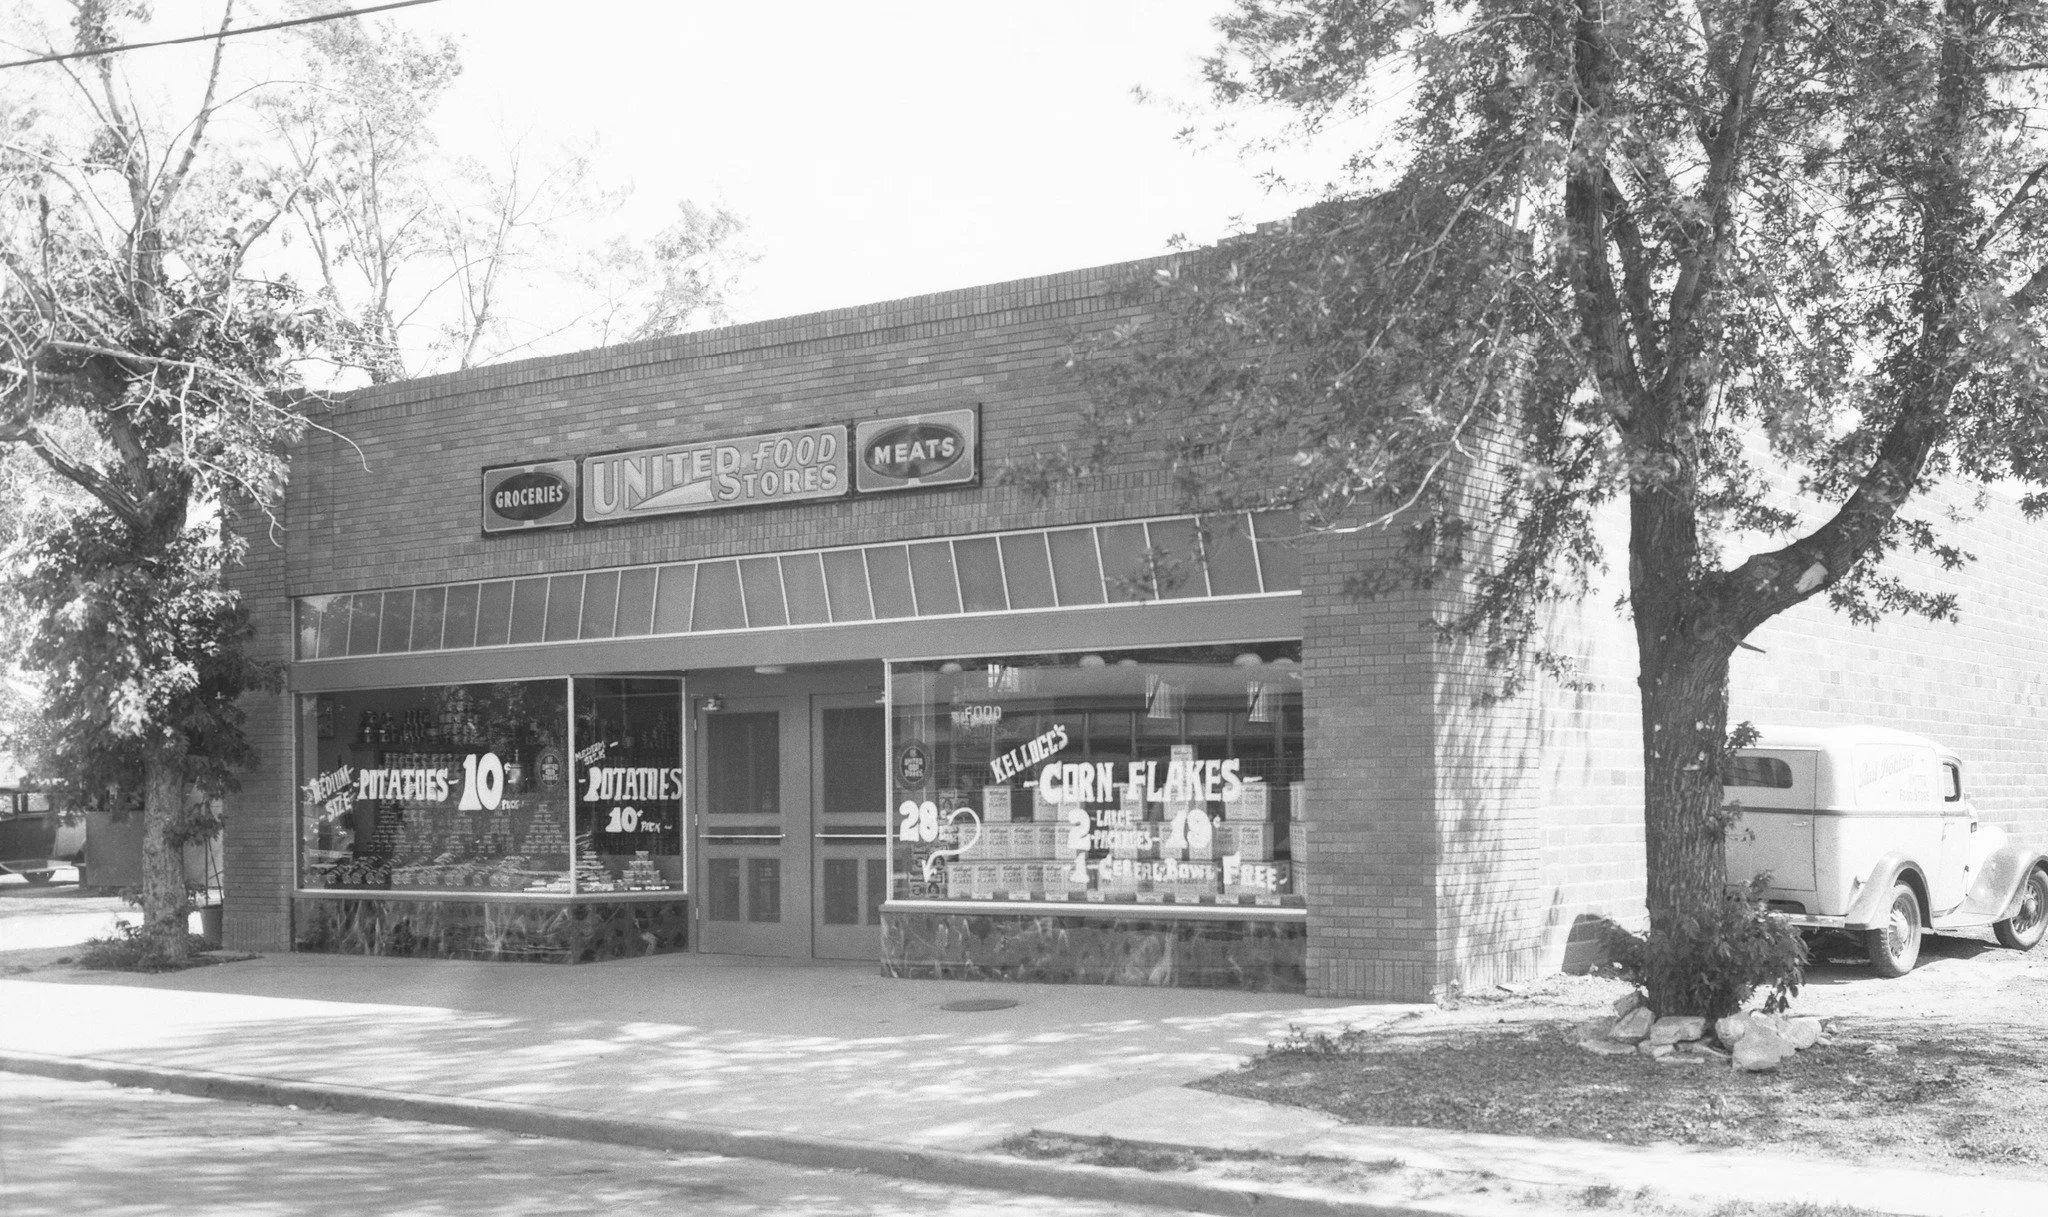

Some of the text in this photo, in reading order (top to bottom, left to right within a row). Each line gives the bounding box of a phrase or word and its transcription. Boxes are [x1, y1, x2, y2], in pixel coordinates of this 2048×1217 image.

[751, 433, 837, 470] FOOD
[874, 437, 956, 466] MEATS
[495, 484, 563, 508] GROCERIES
[592, 445, 742, 515] UNITED
[717, 464, 838, 500] STORES
[305, 764, 352, 804] MEDIUM
[357, 768, 449, 802] POTATOES
[583, 766, 683, 801] POTATOES
[1040, 758, 1242, 804] CORN FLAKES
[325, 791, 353, 822] SIZE
[1067, 808, 1091, 851] 2
[1069, 852, 1089, 883] 1
[1222, 852, 1277, 891] FREE
